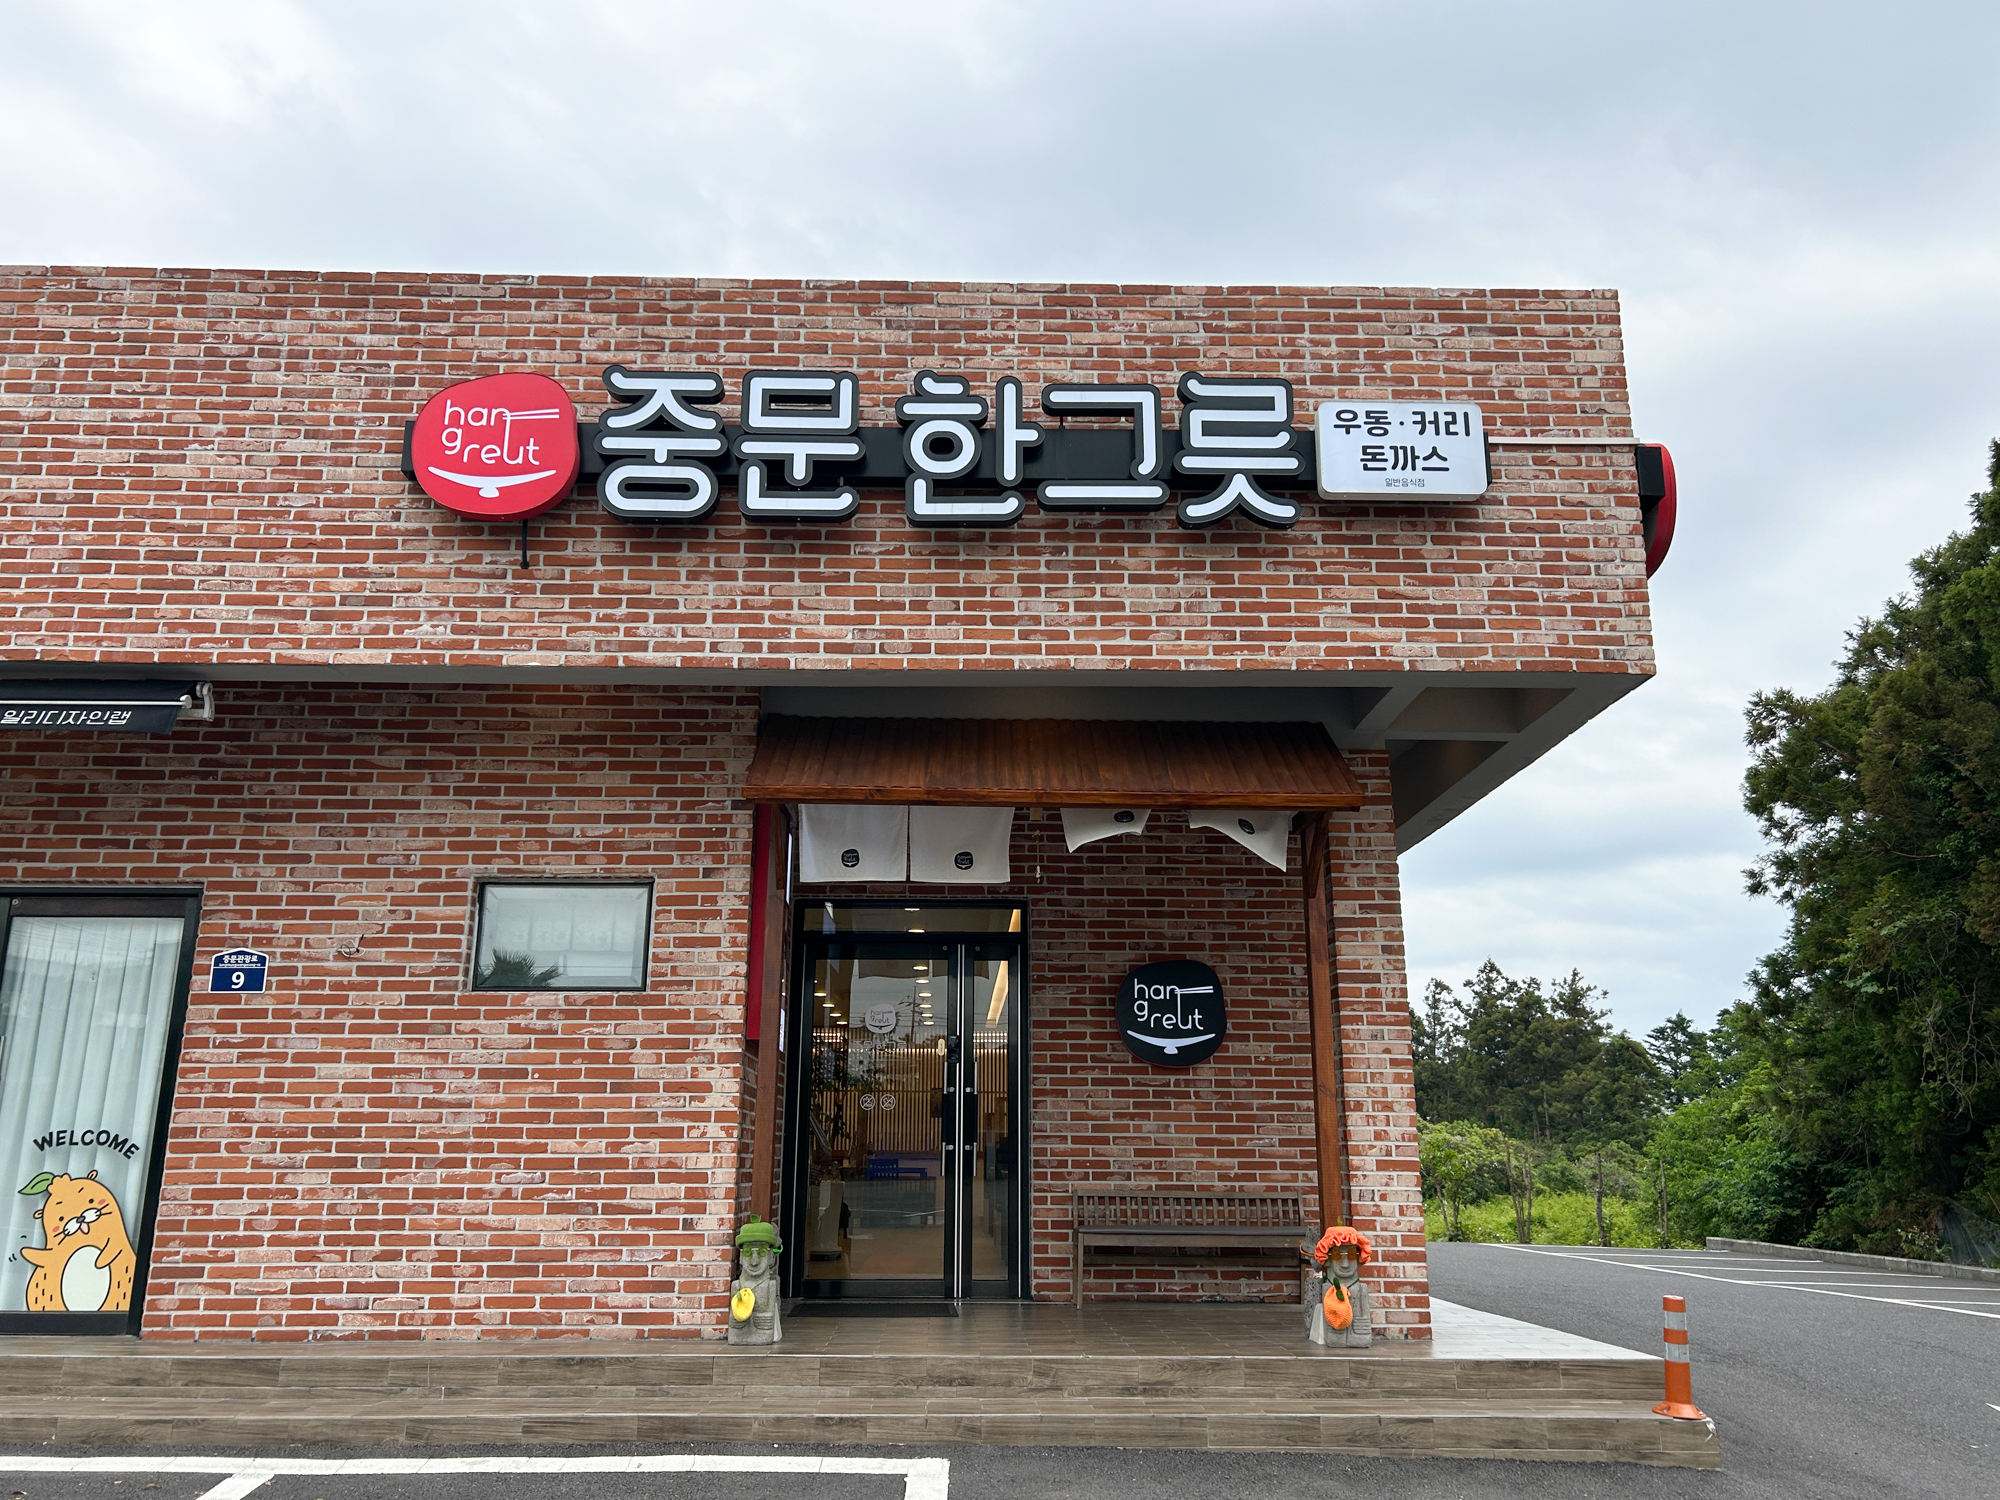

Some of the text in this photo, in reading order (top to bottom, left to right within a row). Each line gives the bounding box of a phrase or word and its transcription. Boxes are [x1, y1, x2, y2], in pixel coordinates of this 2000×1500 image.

[444, 399, 511, 426] han
[441, 426, 540, 465] greut
[1360, 445, 1450, 471] 돈까스
[1384, 477, 1425, 487] 일반음식점
[0, 710, 132, 725] 일리디자인랩
[231, 971, 245, 989] 9
[1134, 978, 1180, 999] han
[1133, 1000, 1204, 1030] greut
[33, 1129, 140, 1159] WELCOME
